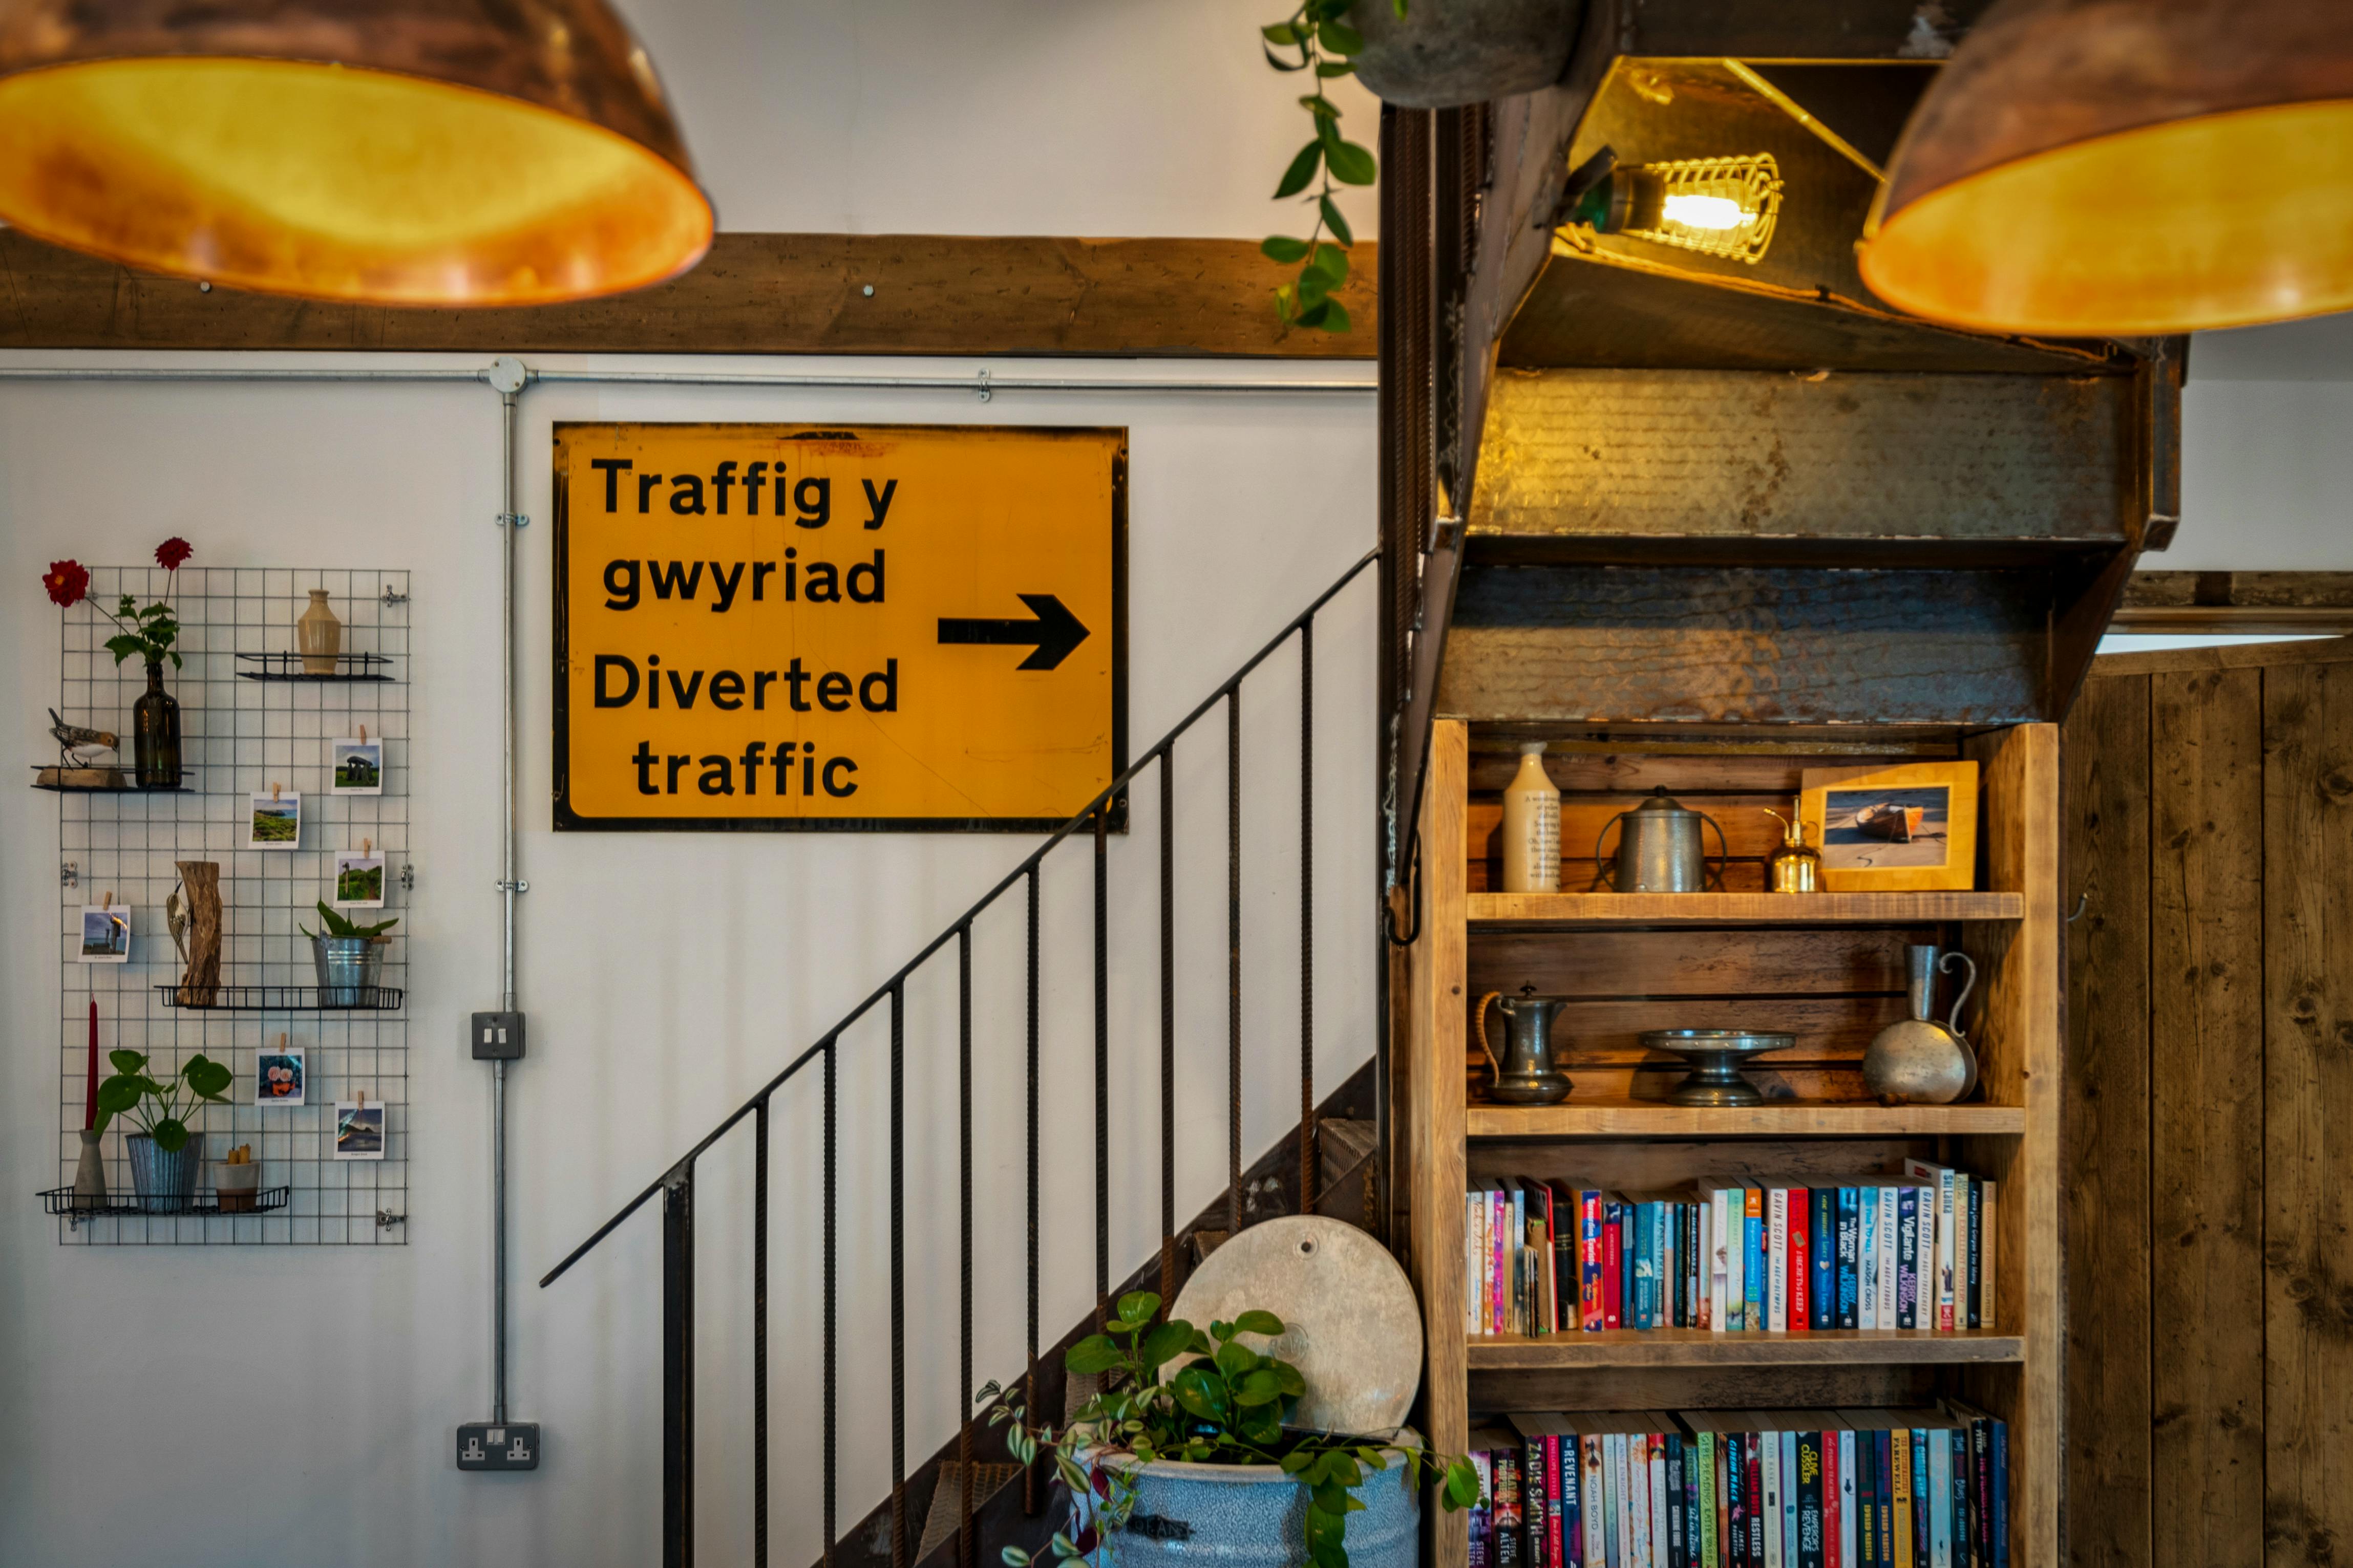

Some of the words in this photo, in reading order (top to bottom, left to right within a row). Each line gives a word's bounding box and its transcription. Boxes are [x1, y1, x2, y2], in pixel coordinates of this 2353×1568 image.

[591, 459, 831, 529] Traffig
[861, 479, 898, 530] y
[603, 547, 885, 613] gwyriad
[593, 654, 898, 713] Diverted
[632, 740, 858, 797] traffic
[1587, 1198, 1596, 1237] Bernardine
[1774, 1193, 1783, 1219] GAVIN
[1884, 1192, 1893, 1218] GAVIN
[1923, 1192, 1932, 1218] GAVIN
[1959, 1205, 1966, 1216] AN
[1774, 1223, 1783, 1251] SCOTT
[1839, 1231, 1848, 1258] Black
[1848, 1227, 1857, 1263] Woman
[1865, 1227, 1873, 1238] TO
[1884, 1221, 1893, 1250] SCOTT
[1901, 1216, 1916, 1261] Vigilante
[1923, 1221, 1932, 1250] SCOTT
[1587, 1237, 1596, 1267] Evaristo
[1795, 1291, 1804, 1313] KEEP
[1840, 1265, 1848, 1314] WILKINSON
[1848, 1274, 1856, 1303] KERRY
[1900, 1264, 1909, 1313] WILKINSON
[1907, 1273, 1916, 1303] KERRY
[1702, 1435, 1710, 1458] GIRL
[1975, 1429, 1983, 1454] PETERS
[1528, 1443, 1543, 1485] ZADIE
[1729, 1440, 1738, 1473] GIDEON
[1800, 1444, 1811, 1485] CUSSLER
[1809, 1450, 1818, 1476] CLIVE
[1564, 1450, 1577, 1506] REVENANT
[1589, 1475, 1598, 1502] NOAH
[1703, 1463, 1711, 1504] READING
[1730, 1474, 1739, 1502] MACK
[1750, 1458, 1760, 1492] WILLIAM
[1954, 1478, 1966, 1500] Blues
[1528, 1487, 1544, 1535] SMITH
[1590, 1505, 1599, 1531] BOYD
[1751, 1494, 1761, 1515] BOYD
[1863, 1504, 1872, 1531] EDWARD
[1880, 1505, 1889, 1532] EDWARD
[1751, 1517, 1762, 1557] RESTLESS
[1801, 1510, 1812, 1552] REVENGE
[1811, 1509, 1819, 1552] EMPEROR'S
[1476, 1540, 1484, 1565] STEVE
[1499, 1532, 1510, 1564] ALTEN
[1864, 1532, 1873, 1561] MARSTON
[1882, 1533, 1890, 1561] MARSTON
